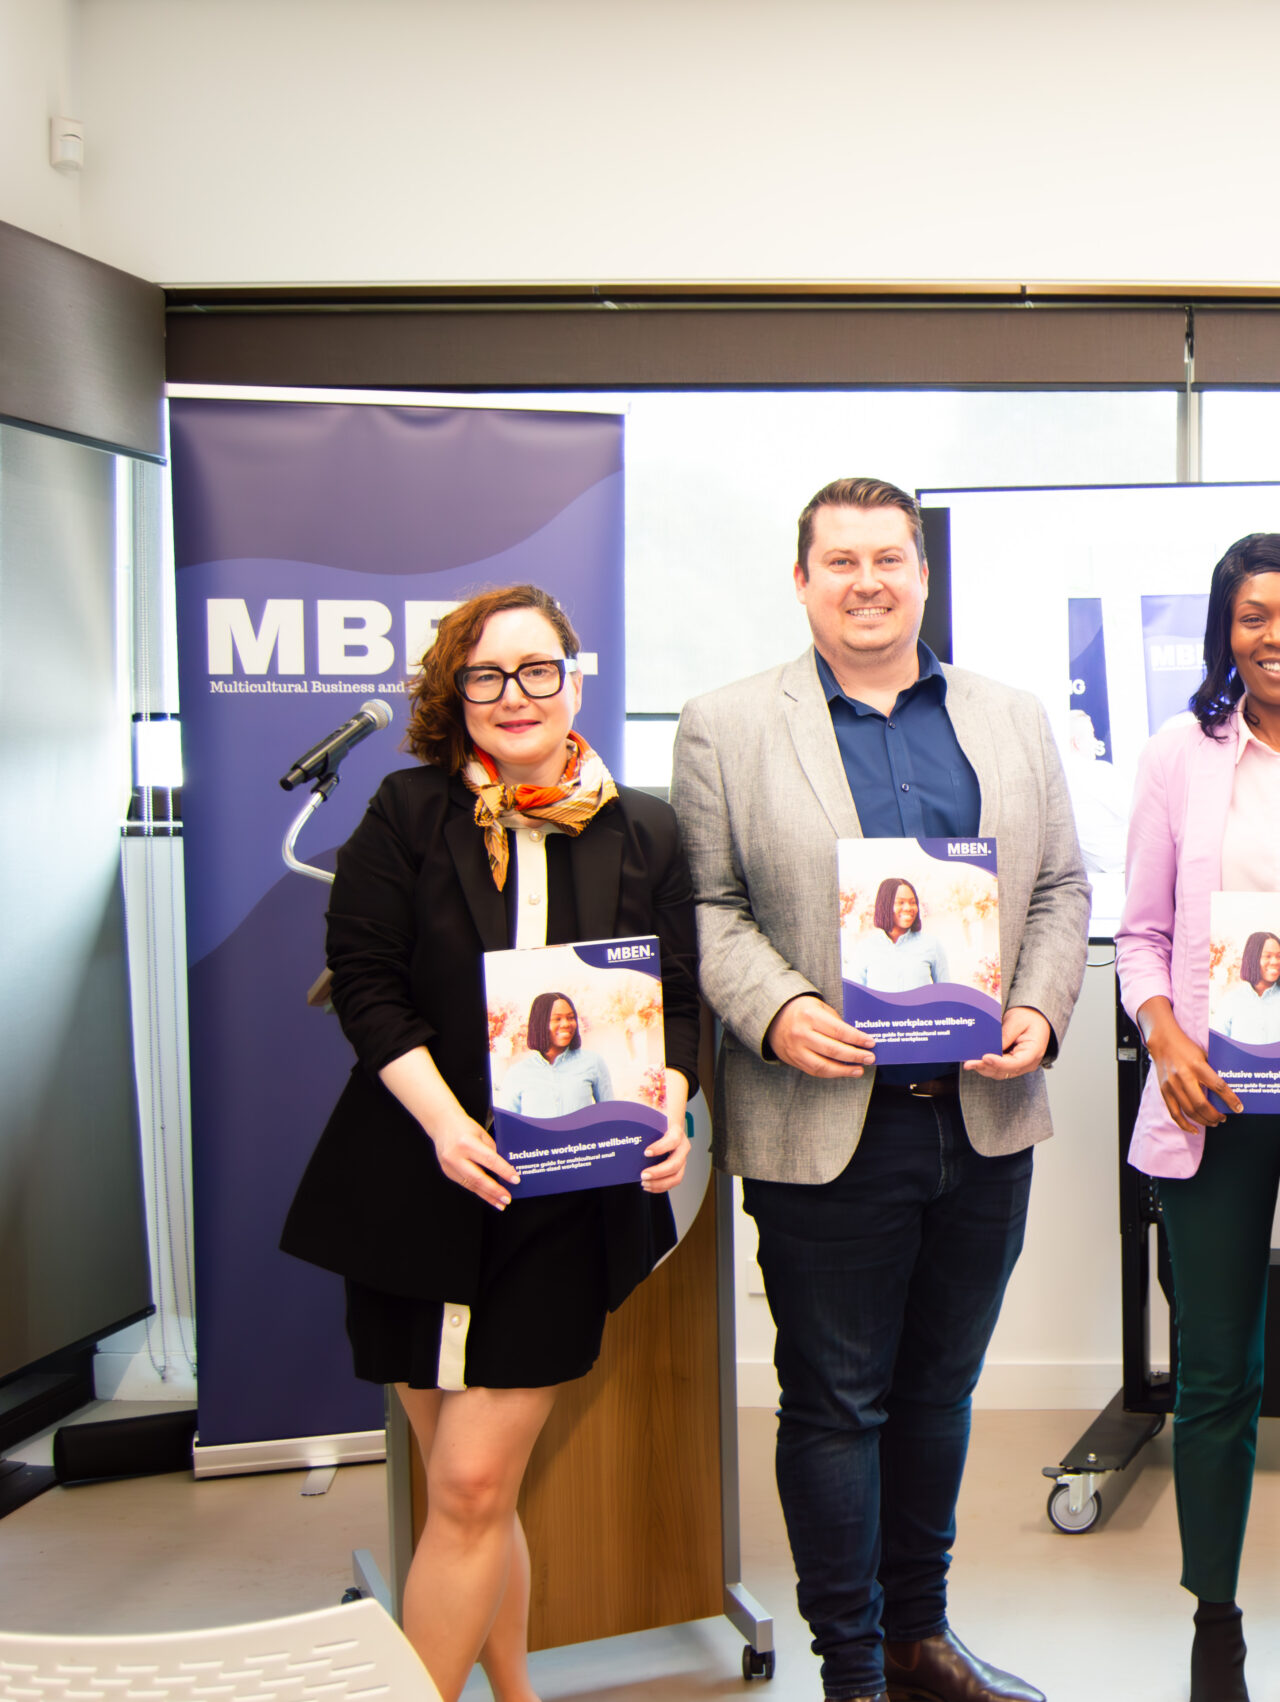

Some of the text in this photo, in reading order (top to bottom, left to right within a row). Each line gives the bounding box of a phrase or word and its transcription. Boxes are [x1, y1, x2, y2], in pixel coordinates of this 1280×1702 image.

[210, 680, 308, 694] Multicultural
[311, 680, 375, 694] Business
[378, 680, 405, 694] and
[948, 842, 992, 855] MBEN.
[607, 944, 655, 961] MBEN.
[855, 1017, 976, 1028] Inclusive workplace wellbeing:
[1217, 1070, 1252, 1079] Inclusive
[509, 1136, 643, 1160] Inclusive workplace wellbeing:
